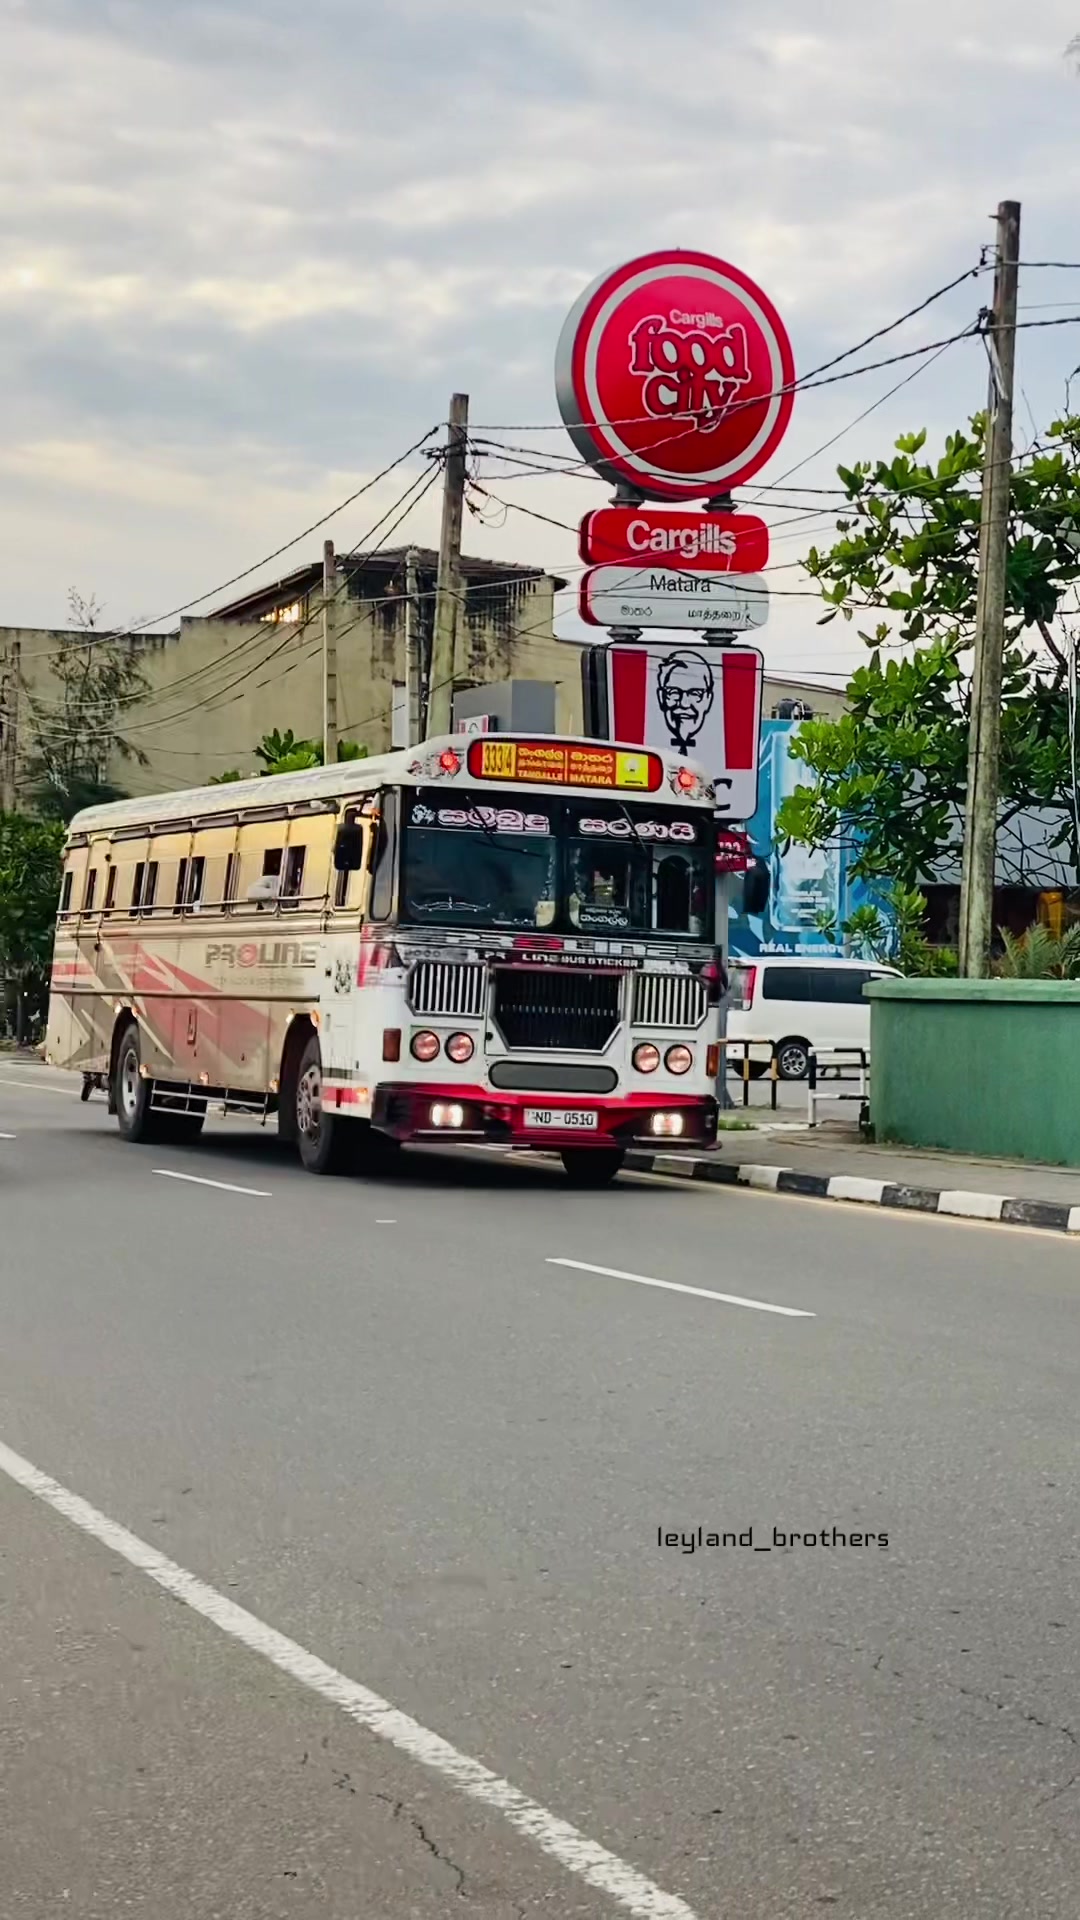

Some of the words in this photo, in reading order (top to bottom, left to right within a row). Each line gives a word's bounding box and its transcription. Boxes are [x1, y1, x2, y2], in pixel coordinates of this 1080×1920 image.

[669, 308, 724, 329] Cargills
[629, 315, 751, 382] food
[643, 368, 740, 432] city
[626, 519, 737, 559] Cargills
[650, 574, 711, 593] Matara
[620, 604, 653, 617] මාතර
[569, 773, 613, 785] MATARA
[205, 942, 319, 968] PROLINE
[759, 943, 793, 953] REAL
